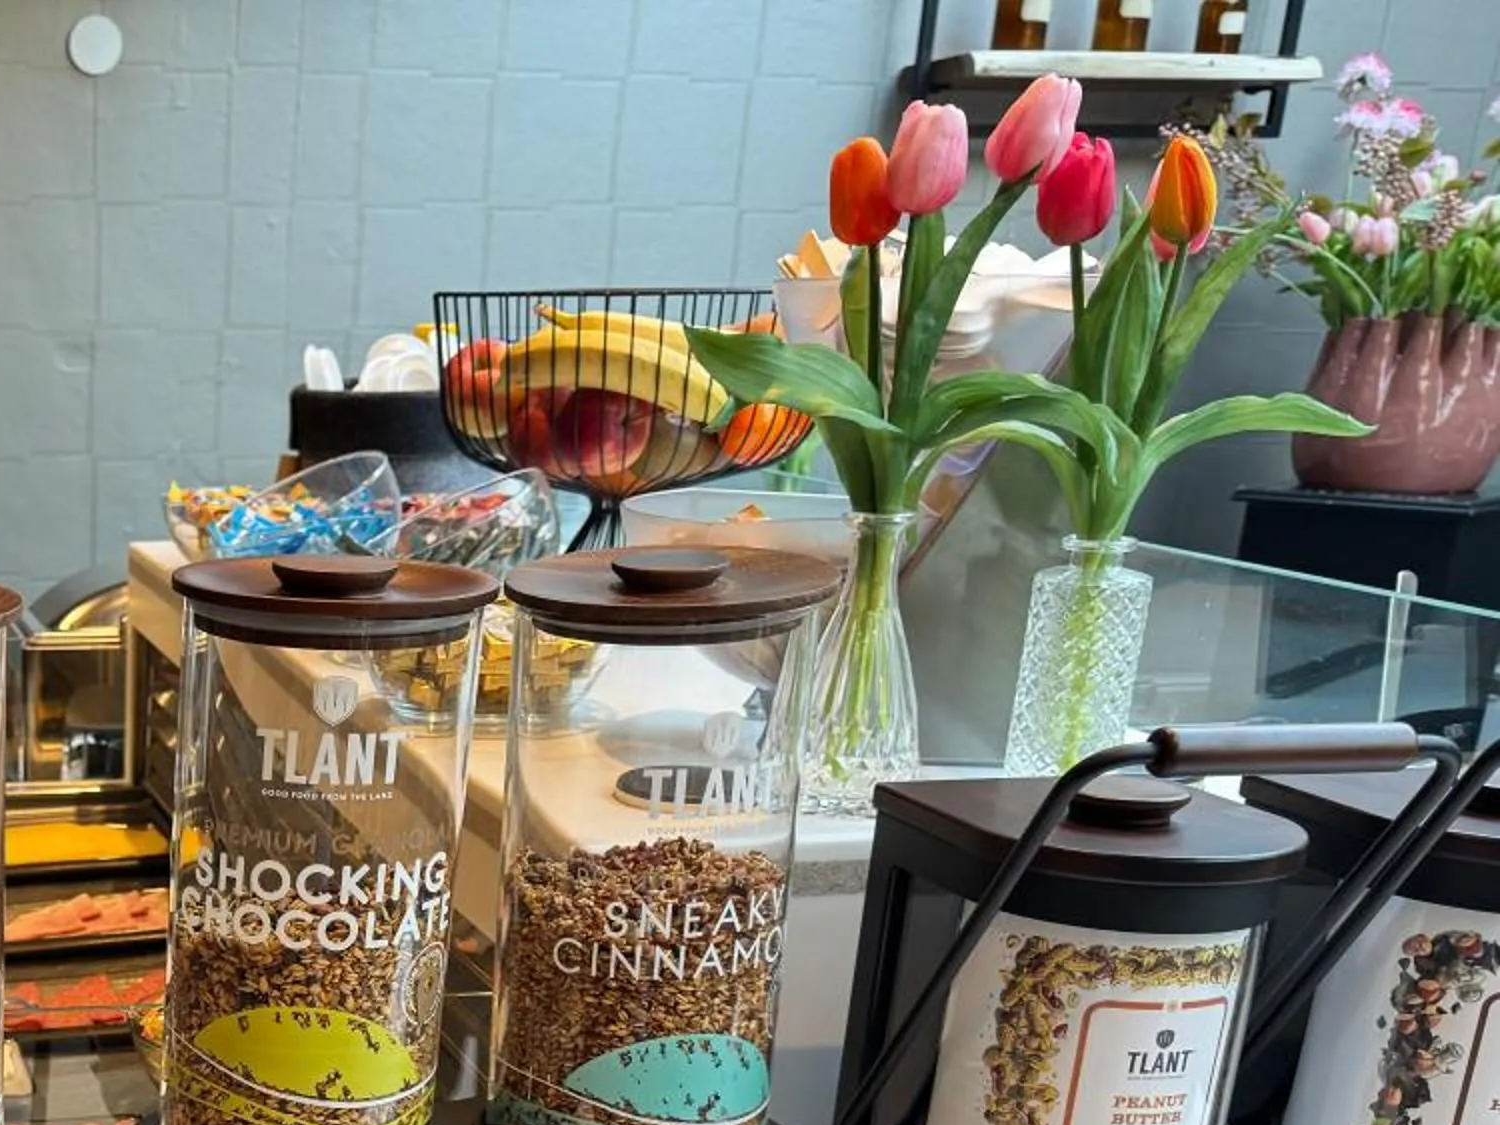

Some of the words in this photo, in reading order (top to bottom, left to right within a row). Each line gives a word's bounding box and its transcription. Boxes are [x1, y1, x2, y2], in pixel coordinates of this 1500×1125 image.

[255, 728, 406, 786] TLANT
[195, 848, 447, 905] SHOCKING
[604, 884, 785, 940] SNEAKY
[553, 924, 787, 981] CINNAMO
[1127, 1049, 1194, 1075] TLANT
[1110, 1093, 1188, 1109] PEANUT
[1110, 1111, 1182, 1125] BUTTER
